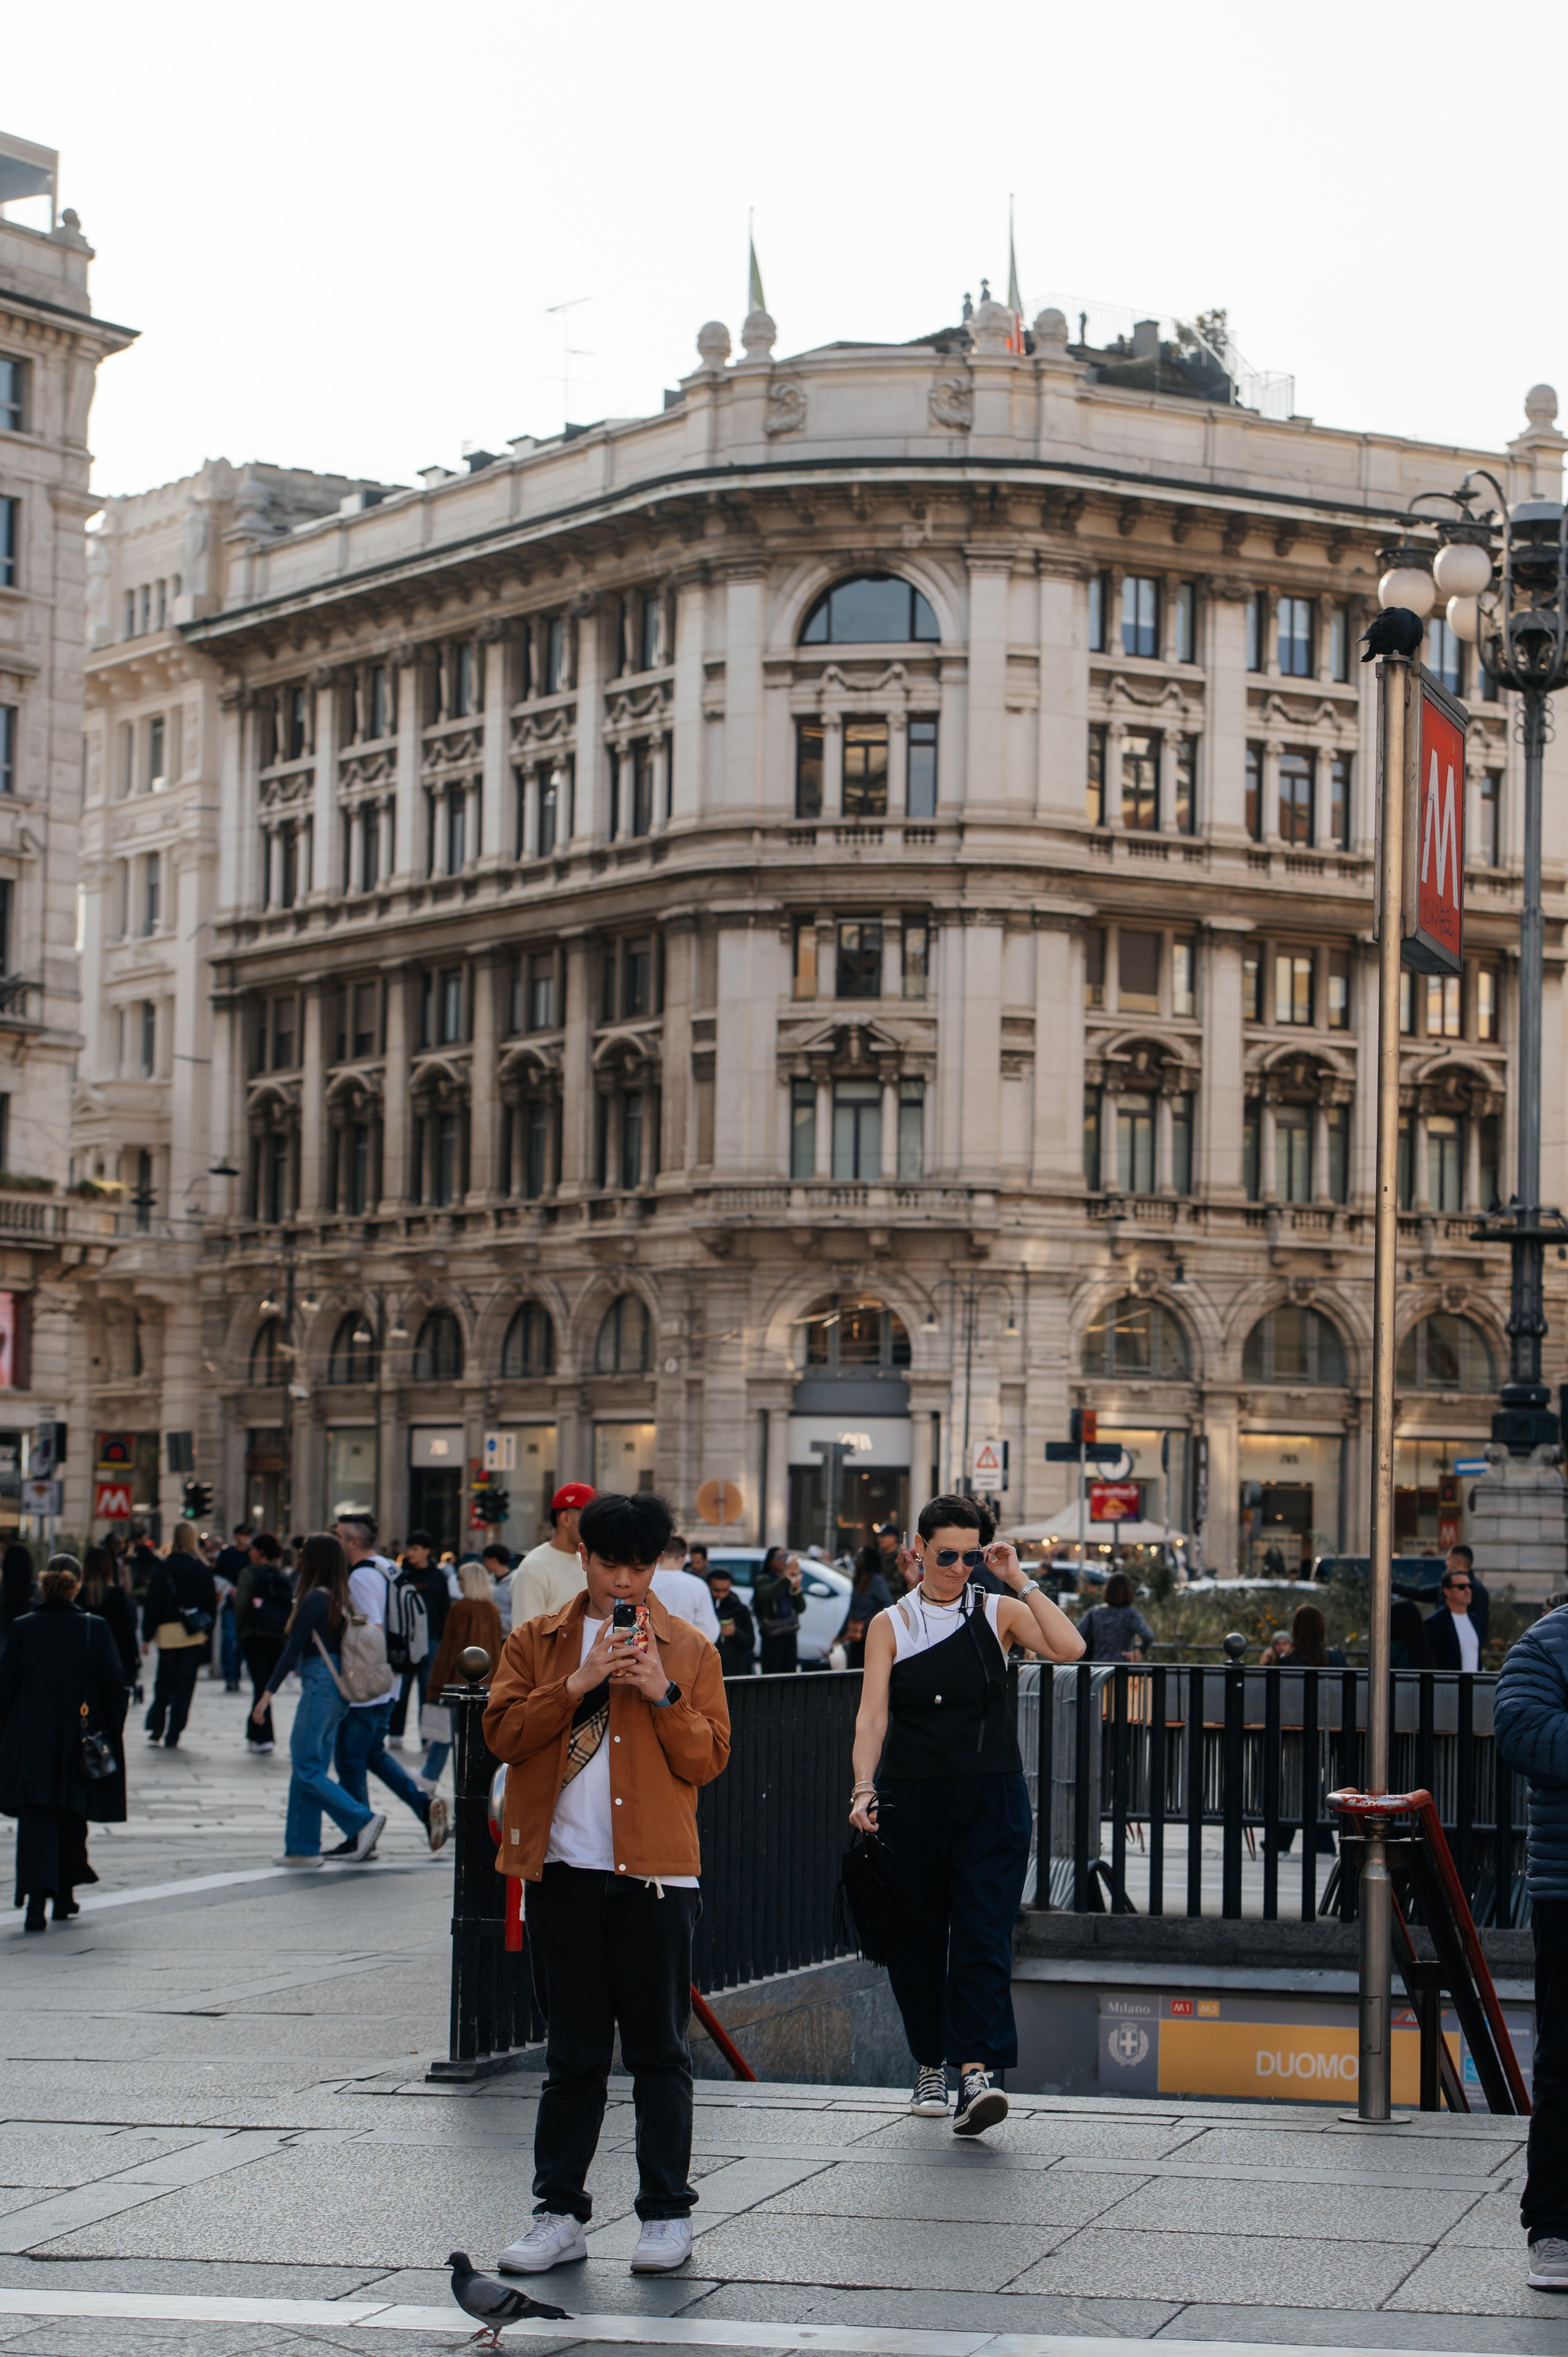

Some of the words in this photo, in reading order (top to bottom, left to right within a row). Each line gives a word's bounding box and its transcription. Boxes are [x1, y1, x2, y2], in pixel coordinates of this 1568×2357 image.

[1421, 749, 1458, 911] M
[99, 1489, 129, 1514] M
[1109, 2001, 1151, 2015] Milano
[1174, 2003, 1189, 2013] M1
[1200, 2004, 1218, 2014] M3
[1256, 2051, 1359, 2081] DUOMO
